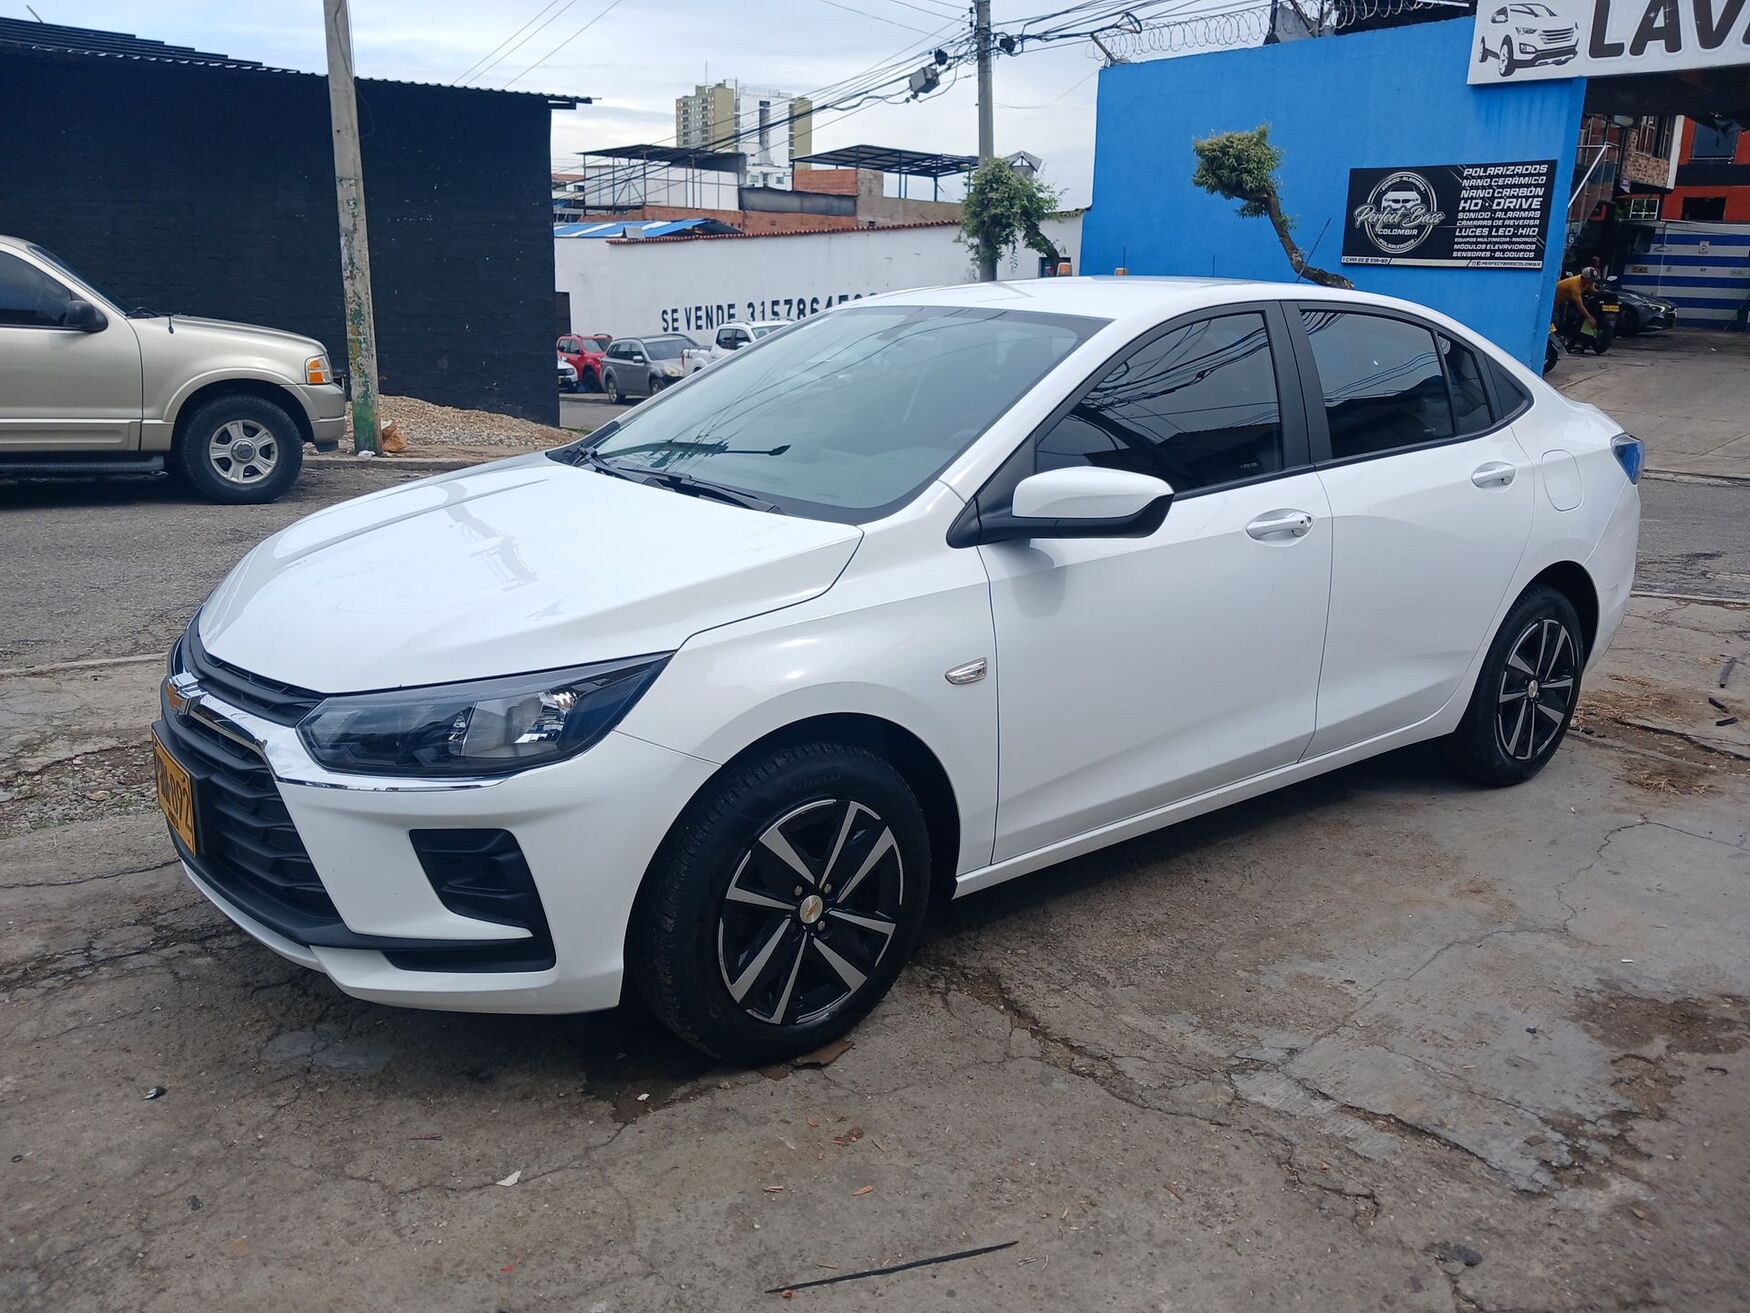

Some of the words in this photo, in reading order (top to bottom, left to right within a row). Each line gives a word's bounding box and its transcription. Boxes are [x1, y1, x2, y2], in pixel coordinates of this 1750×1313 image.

[1588, 0, 1750, 58] LAV
[1463, 164, 1548, 176] POLARIZADOS
[1462, 178, 1490, 187] NANO
[1460, 189, 1492, 198] NANO
[1494, 186, 1544, 197] CARBÓN
[1458, 200, 1482, 210] HD
[1492, 198, 1543, 210] DRIVE
[1355, 204, 1405, 232] Perfect
[1401, 204, 1445, 227] Bass
[1494, 210, 1541, 218] ALARMAS
[1377, 228, 1418, 236] COLOMBIA
[1456, 228, 1489, 236] LUCES
[1492, 228, 1514, 236] LED
[1518, 228, 1539, 236] HID
[662, 308, 679, 332] SE
[684, 304, 736, 331] VENDE
[746, 292, 877, 321] 3157864
